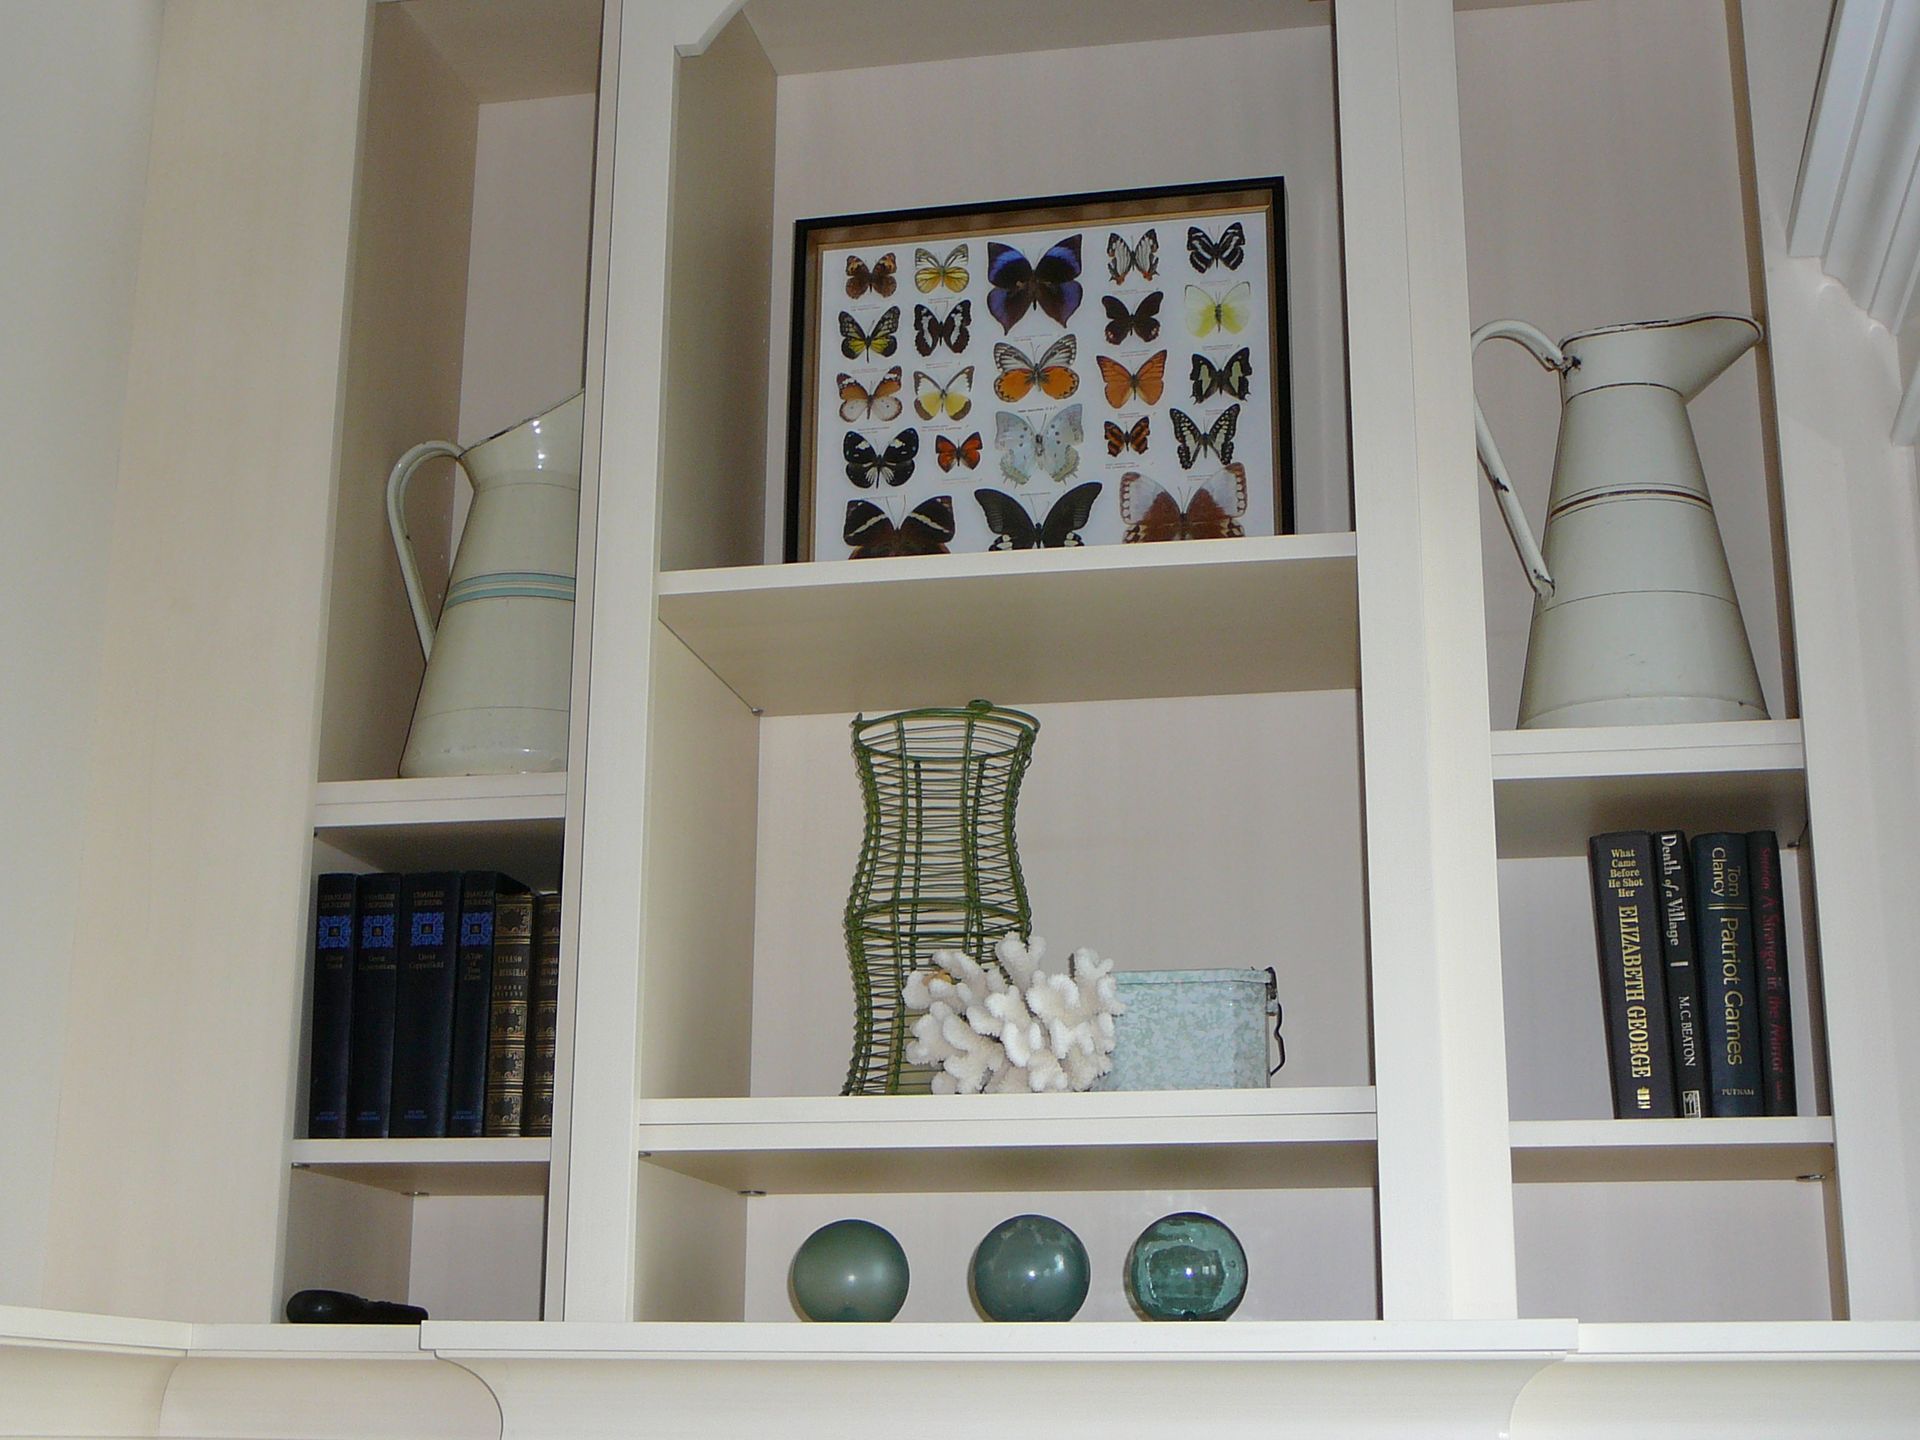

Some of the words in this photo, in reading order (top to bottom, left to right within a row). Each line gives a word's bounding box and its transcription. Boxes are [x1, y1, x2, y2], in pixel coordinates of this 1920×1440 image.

[1610, 869, 1640, 878] Before
[1611, 848, 1636, 858] What
[1611, 858, 1637, 868] Came
[1661, 834, 1681, 875] Death
[1711, 847, 1728, 897] Clancy
[1608, 879, 1621, 888] He
[1622, 877, 1644, 887] Shot
[1617, 888, 1636, 898] Her
[1661, 879, 1680, 891] of
[1727, 866, 1740, 897] Tom
[1666, 898, 1686, 947] Village
[1619, 904, 1645, 1002] ELIZABETH
[1720, 917, 1741, 985] Patriot
[1626, 1005, 1652, 1078] GEORGE
[1681, 1022, 1696, 1067] BEATON
[1724, 990, 1744, 1066] Games
